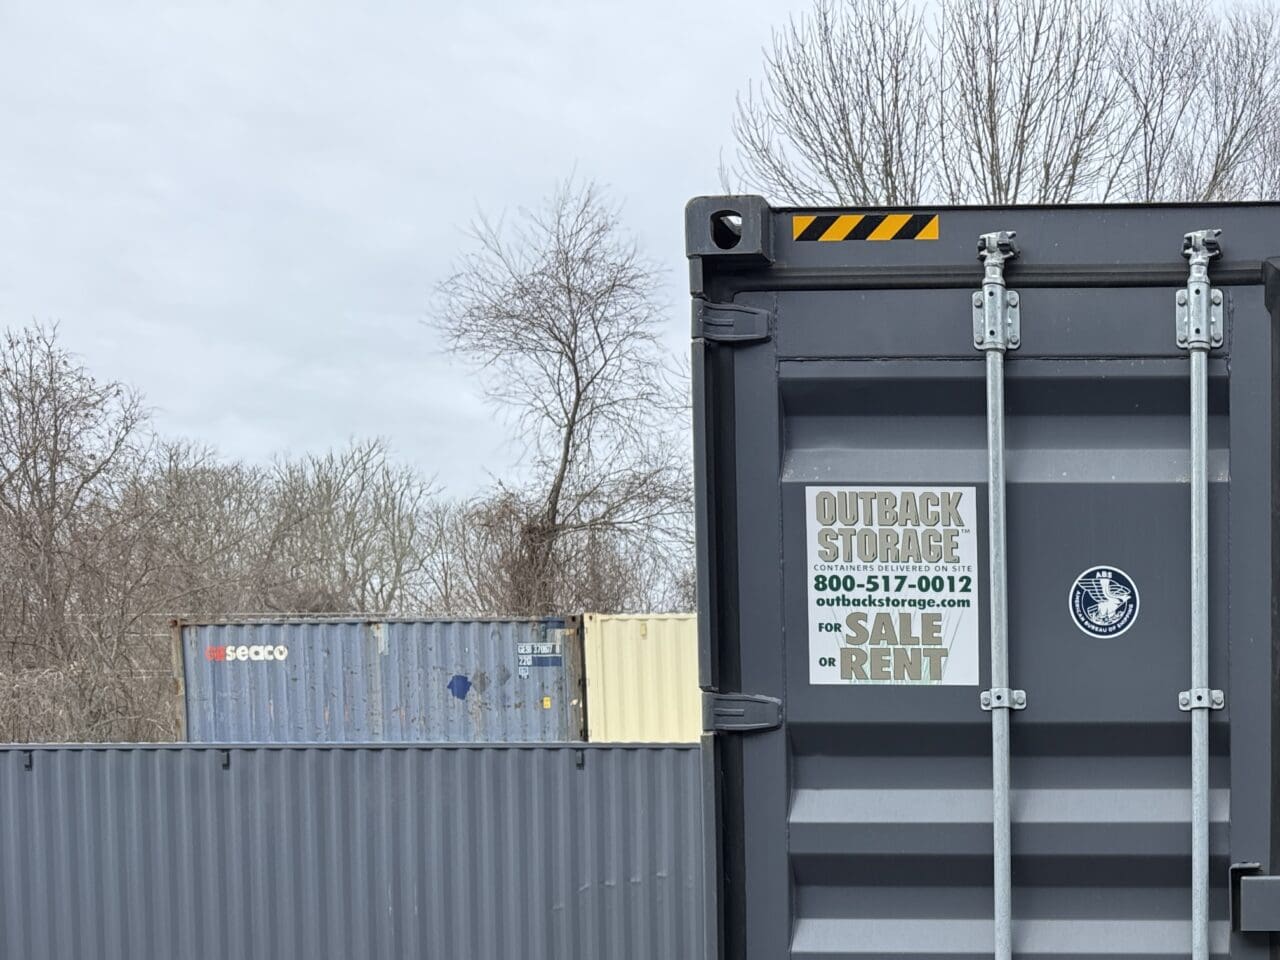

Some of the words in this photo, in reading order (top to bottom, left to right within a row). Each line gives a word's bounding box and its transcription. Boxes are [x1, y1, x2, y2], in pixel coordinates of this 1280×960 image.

[816, 491, 965, 527] OUTBACK
[817, 528, 960, 563] STORAGE
[814, 575, 971, 593] 800-517-0012
[816, 595, 970, 609] outbackstorage.com
[819, 623, 841, 632] FOR
[845, 612, 942, 645] SALE
[819, 657, 836, 667] OR
[840, 648, 948, 680] RENT
